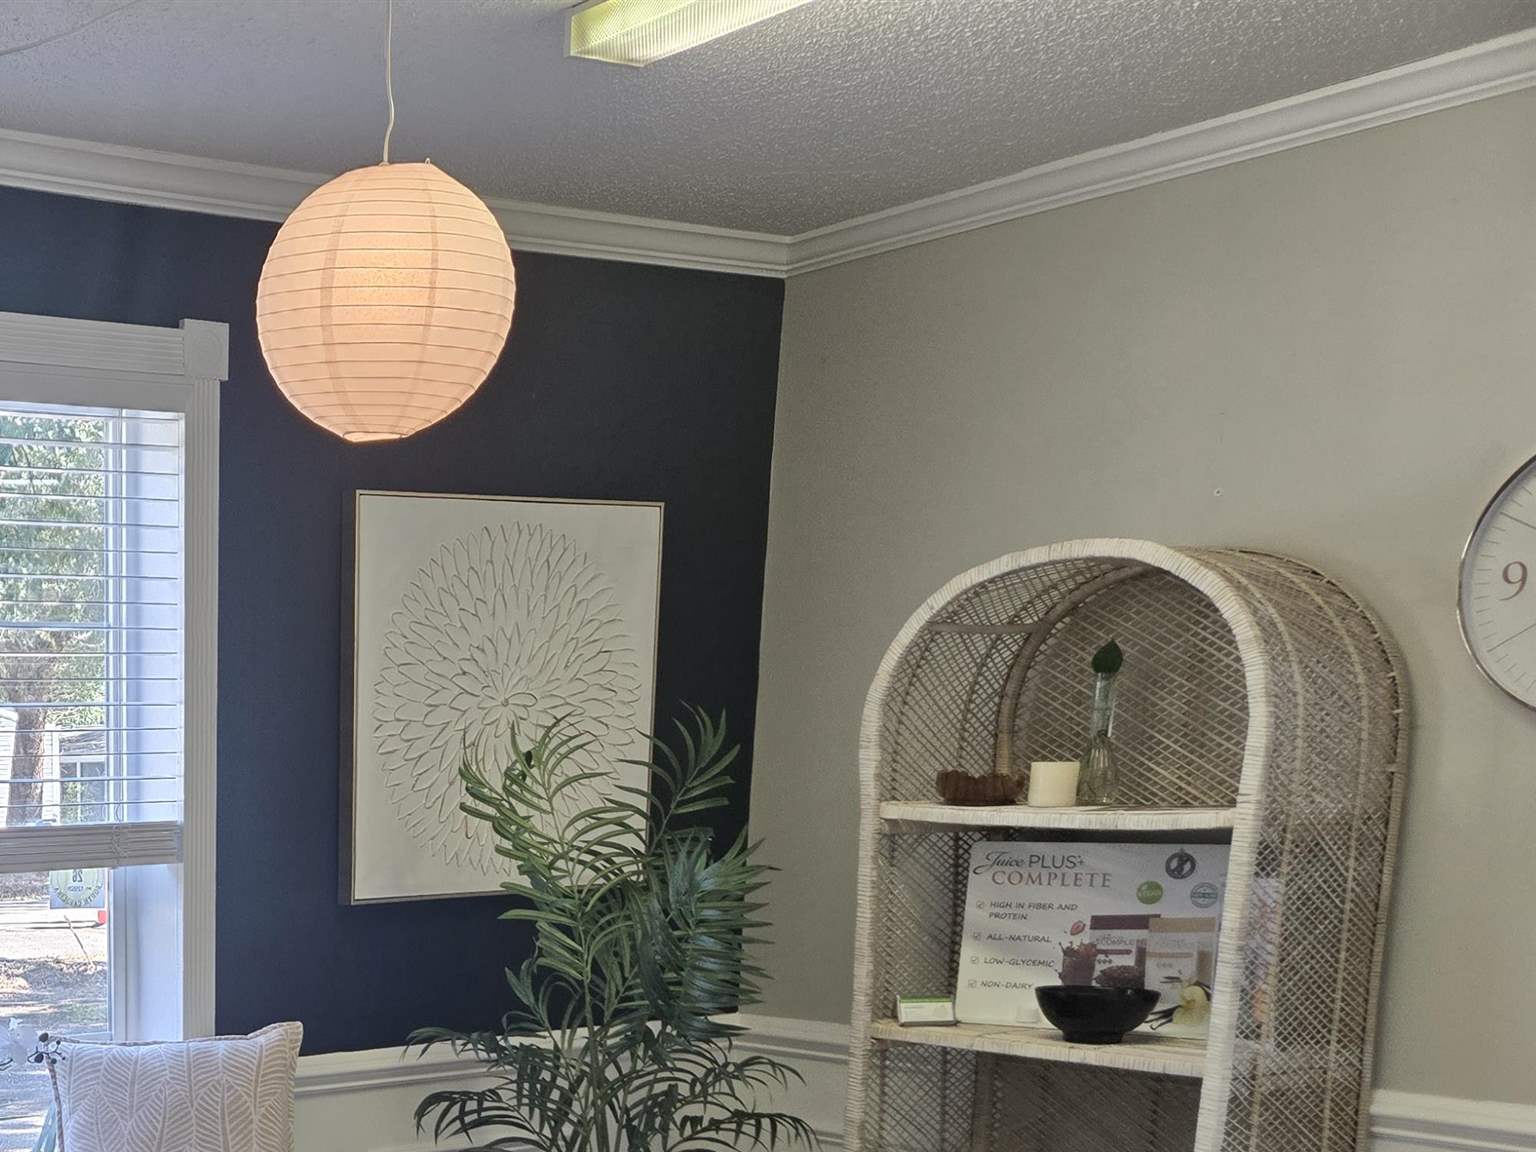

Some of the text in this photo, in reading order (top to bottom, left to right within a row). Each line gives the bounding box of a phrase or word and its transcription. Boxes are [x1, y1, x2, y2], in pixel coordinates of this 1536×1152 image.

[1499, 561, 1528, 601] 9
[973, 851, 1026, 875] Juice
[991, 870, 1113, 888] COMPLETE
[990, 901, 1012, 909] HIGH
[1015, 901, 1025, 909] IN
[1027, 903, 1054, 911] FIBER
[988, 912, 1029, 920] PROTEIN
[986, 933, 1053, 943] ALL-NATURAL
[983, 957, 1056, 968] LOW-GLYCEMIC
[980, 981, 1034, 990] NON-DAIRY
